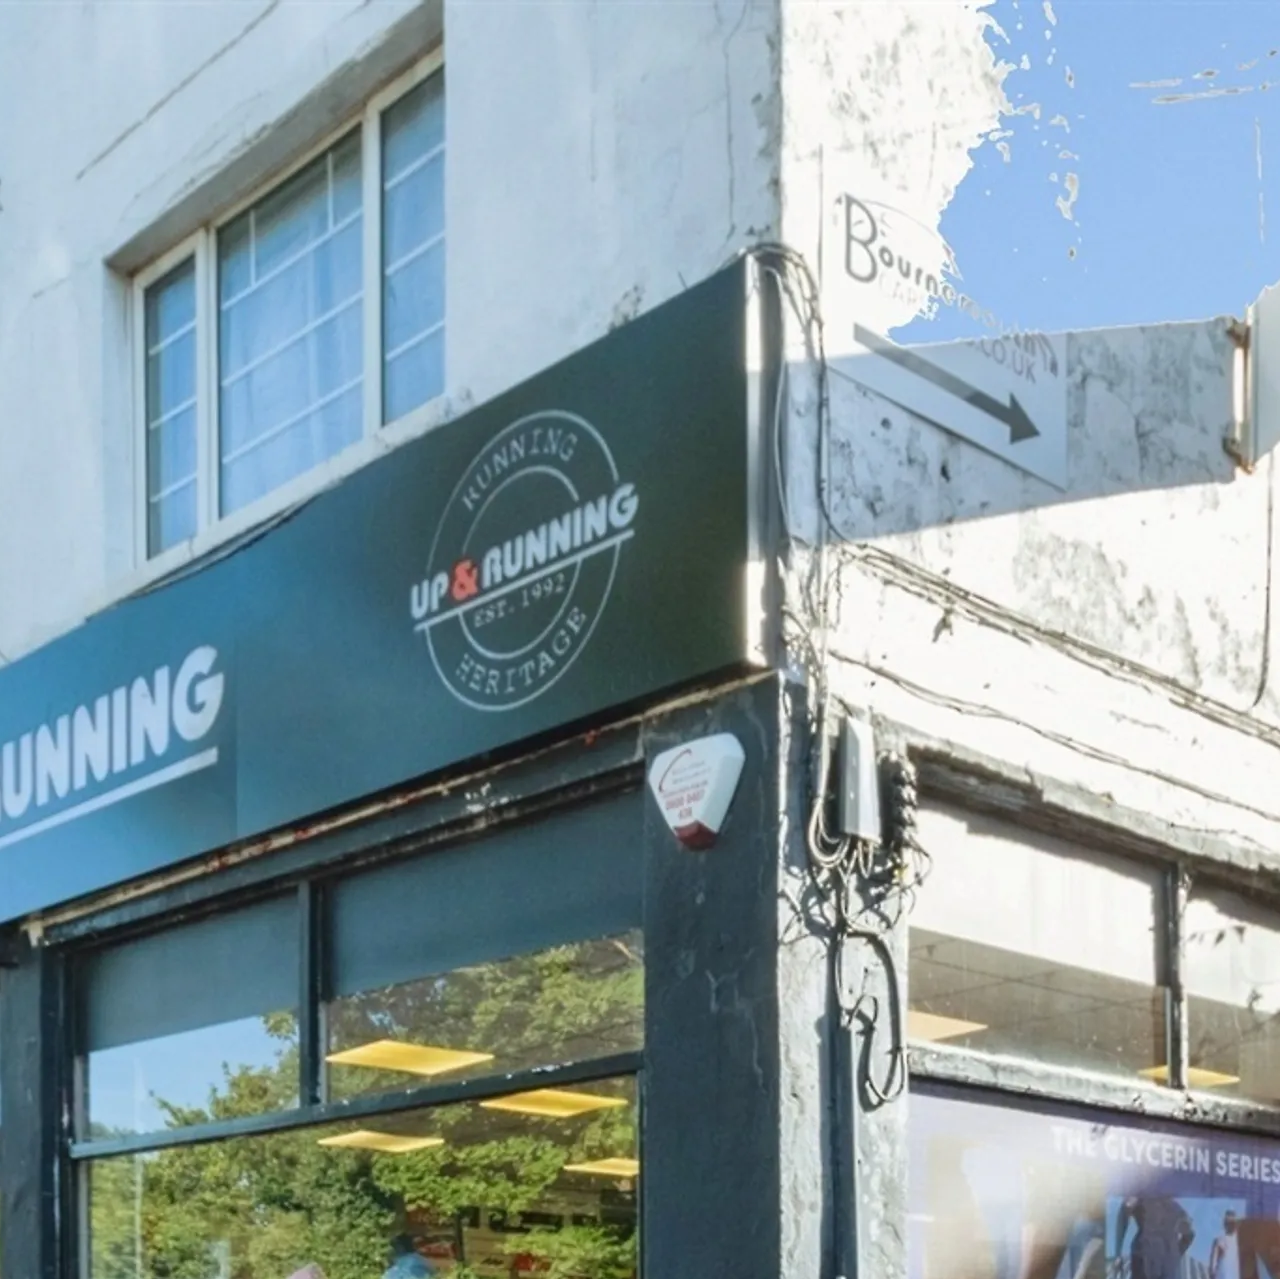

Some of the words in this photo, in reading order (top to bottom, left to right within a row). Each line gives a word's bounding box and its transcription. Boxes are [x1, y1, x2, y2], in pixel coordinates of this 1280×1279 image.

[462, 427, 578, 511] RUNNING
[482, 482, 640, 589] RUNNING
[474, 597, 516, 628] EST.
[521, 573, 565, 609] 1992
[455, 605, 587, 696] HERITAGE
[1049, 1125, 1097, 1157] THE
[1103, 1131, 1210, 1174] GLYCERIN
